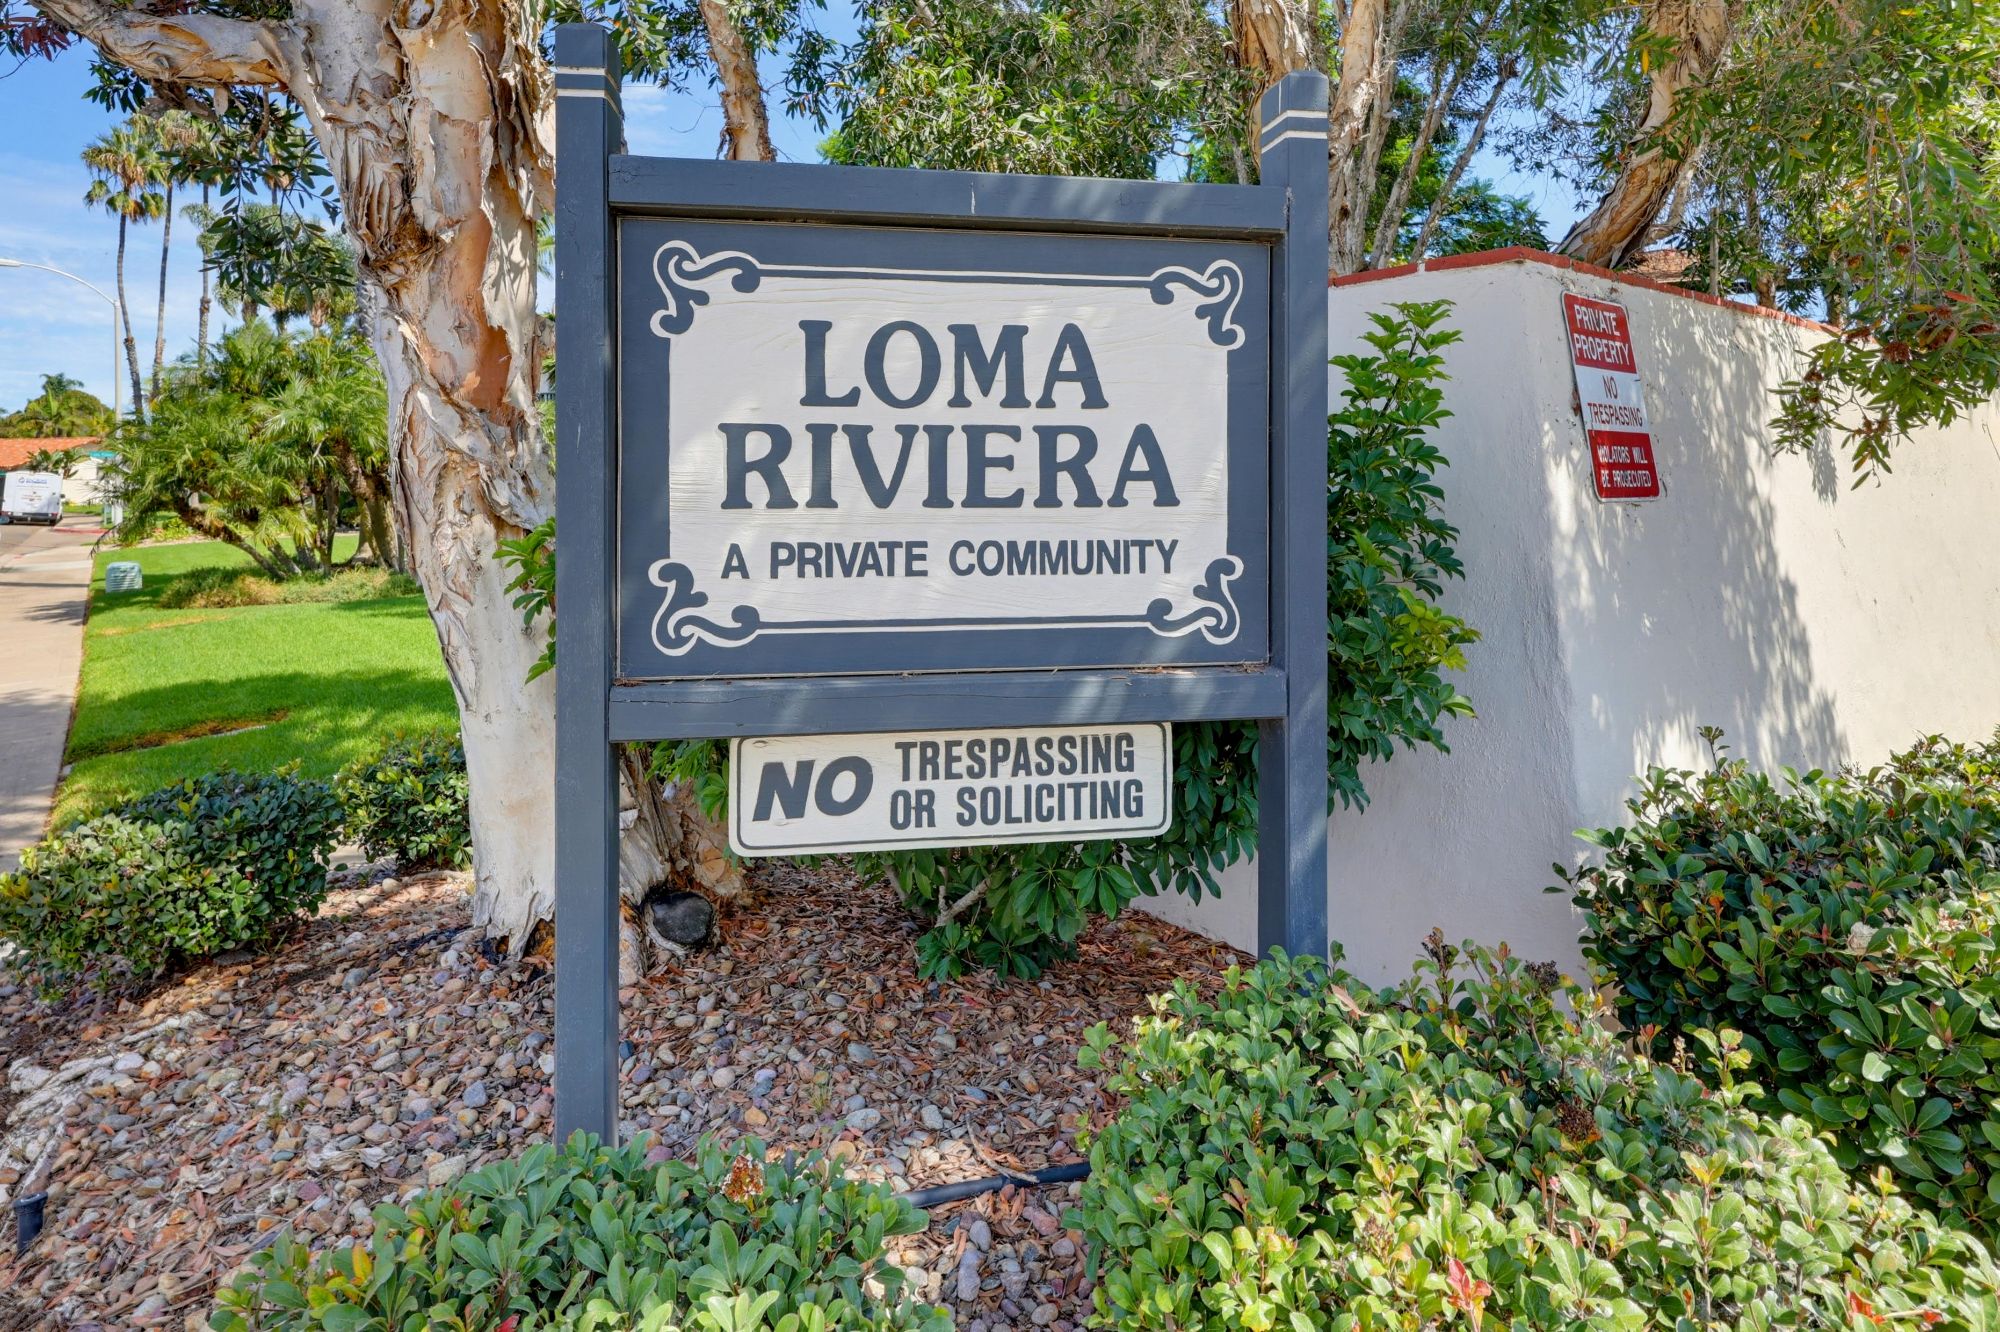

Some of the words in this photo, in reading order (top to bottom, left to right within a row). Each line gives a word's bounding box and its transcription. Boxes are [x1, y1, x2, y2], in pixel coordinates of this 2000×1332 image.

[1574, 304, 1621, 337] PRIVATE
[798, 319, 1110, 410] LOMA
[1573, 334, 1631, 366] PROPERTY
[1602, 375, 1618, 400] NO
[1587, 402, 1643, 427] TRESPASSING
[717, 422, 1181, 510] RIVIERA
[1596, 444, 1630, 464] VIOLATORS
[1632, 446, 1648, 464] WILL
[1601, 469, 1610, 488] BE
[1613, 470, 1652, 488] PROSECUTED
[720, 543, 750, 580] A
[769, 540, 929, 580] PRIVATE
[948, 538, 1179, 577] COMMUNITY
[894, 732, 1135, 782] TRESPASSING
[752, 755, 874, 822] NO
[889, 788, 937, 831] OR
[956, 778, 1144, 827] SOLICITING
